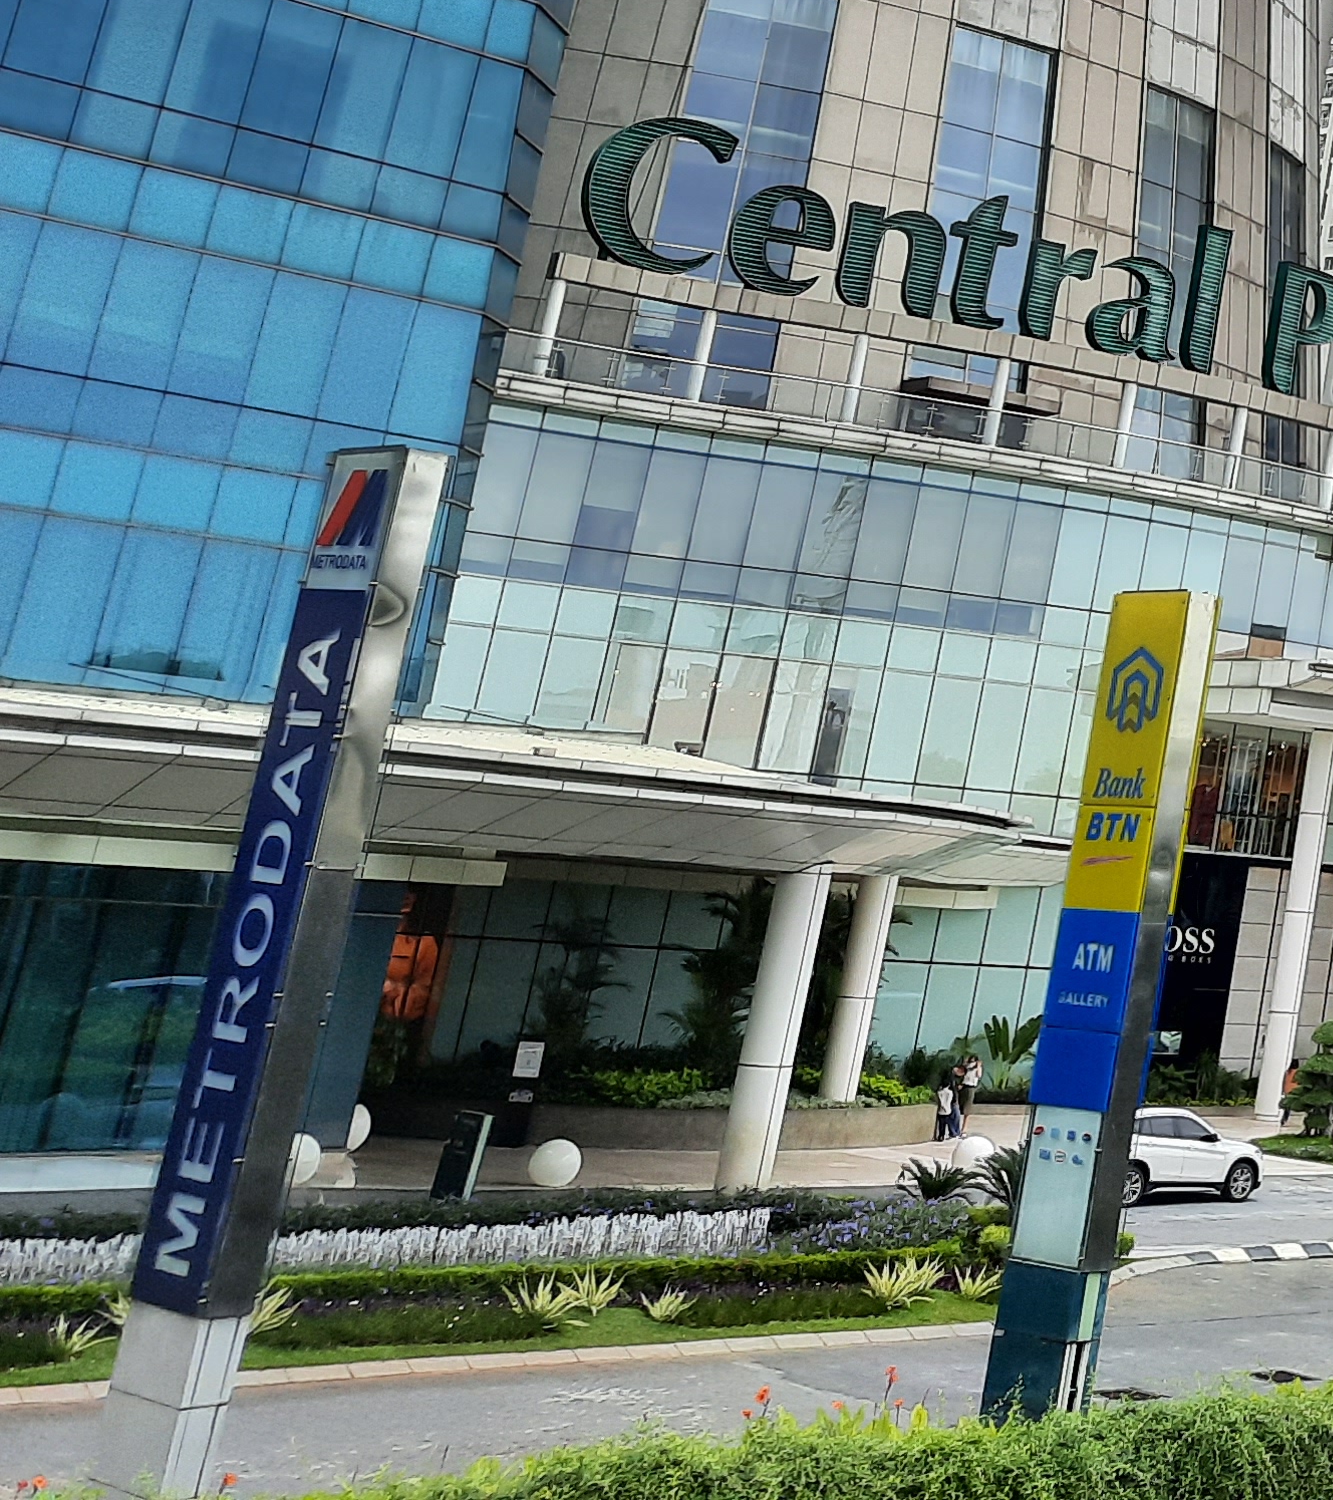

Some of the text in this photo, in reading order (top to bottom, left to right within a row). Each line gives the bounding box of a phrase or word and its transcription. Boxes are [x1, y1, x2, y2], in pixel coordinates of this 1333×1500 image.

[581, 116, 1233, 374] Central
[310, 553, 367, 570] METRODATA
[1092, 767, 1146, 800] Bank
[1085, 812, 1141, 844] BTN
[154, 627, 342, 1279] METRODATA
[1165, 926, 1215, 954] OSS
[1071, 943, 1115, 974] ATM
[1058, 991, 1110, 1008] GALLERY
